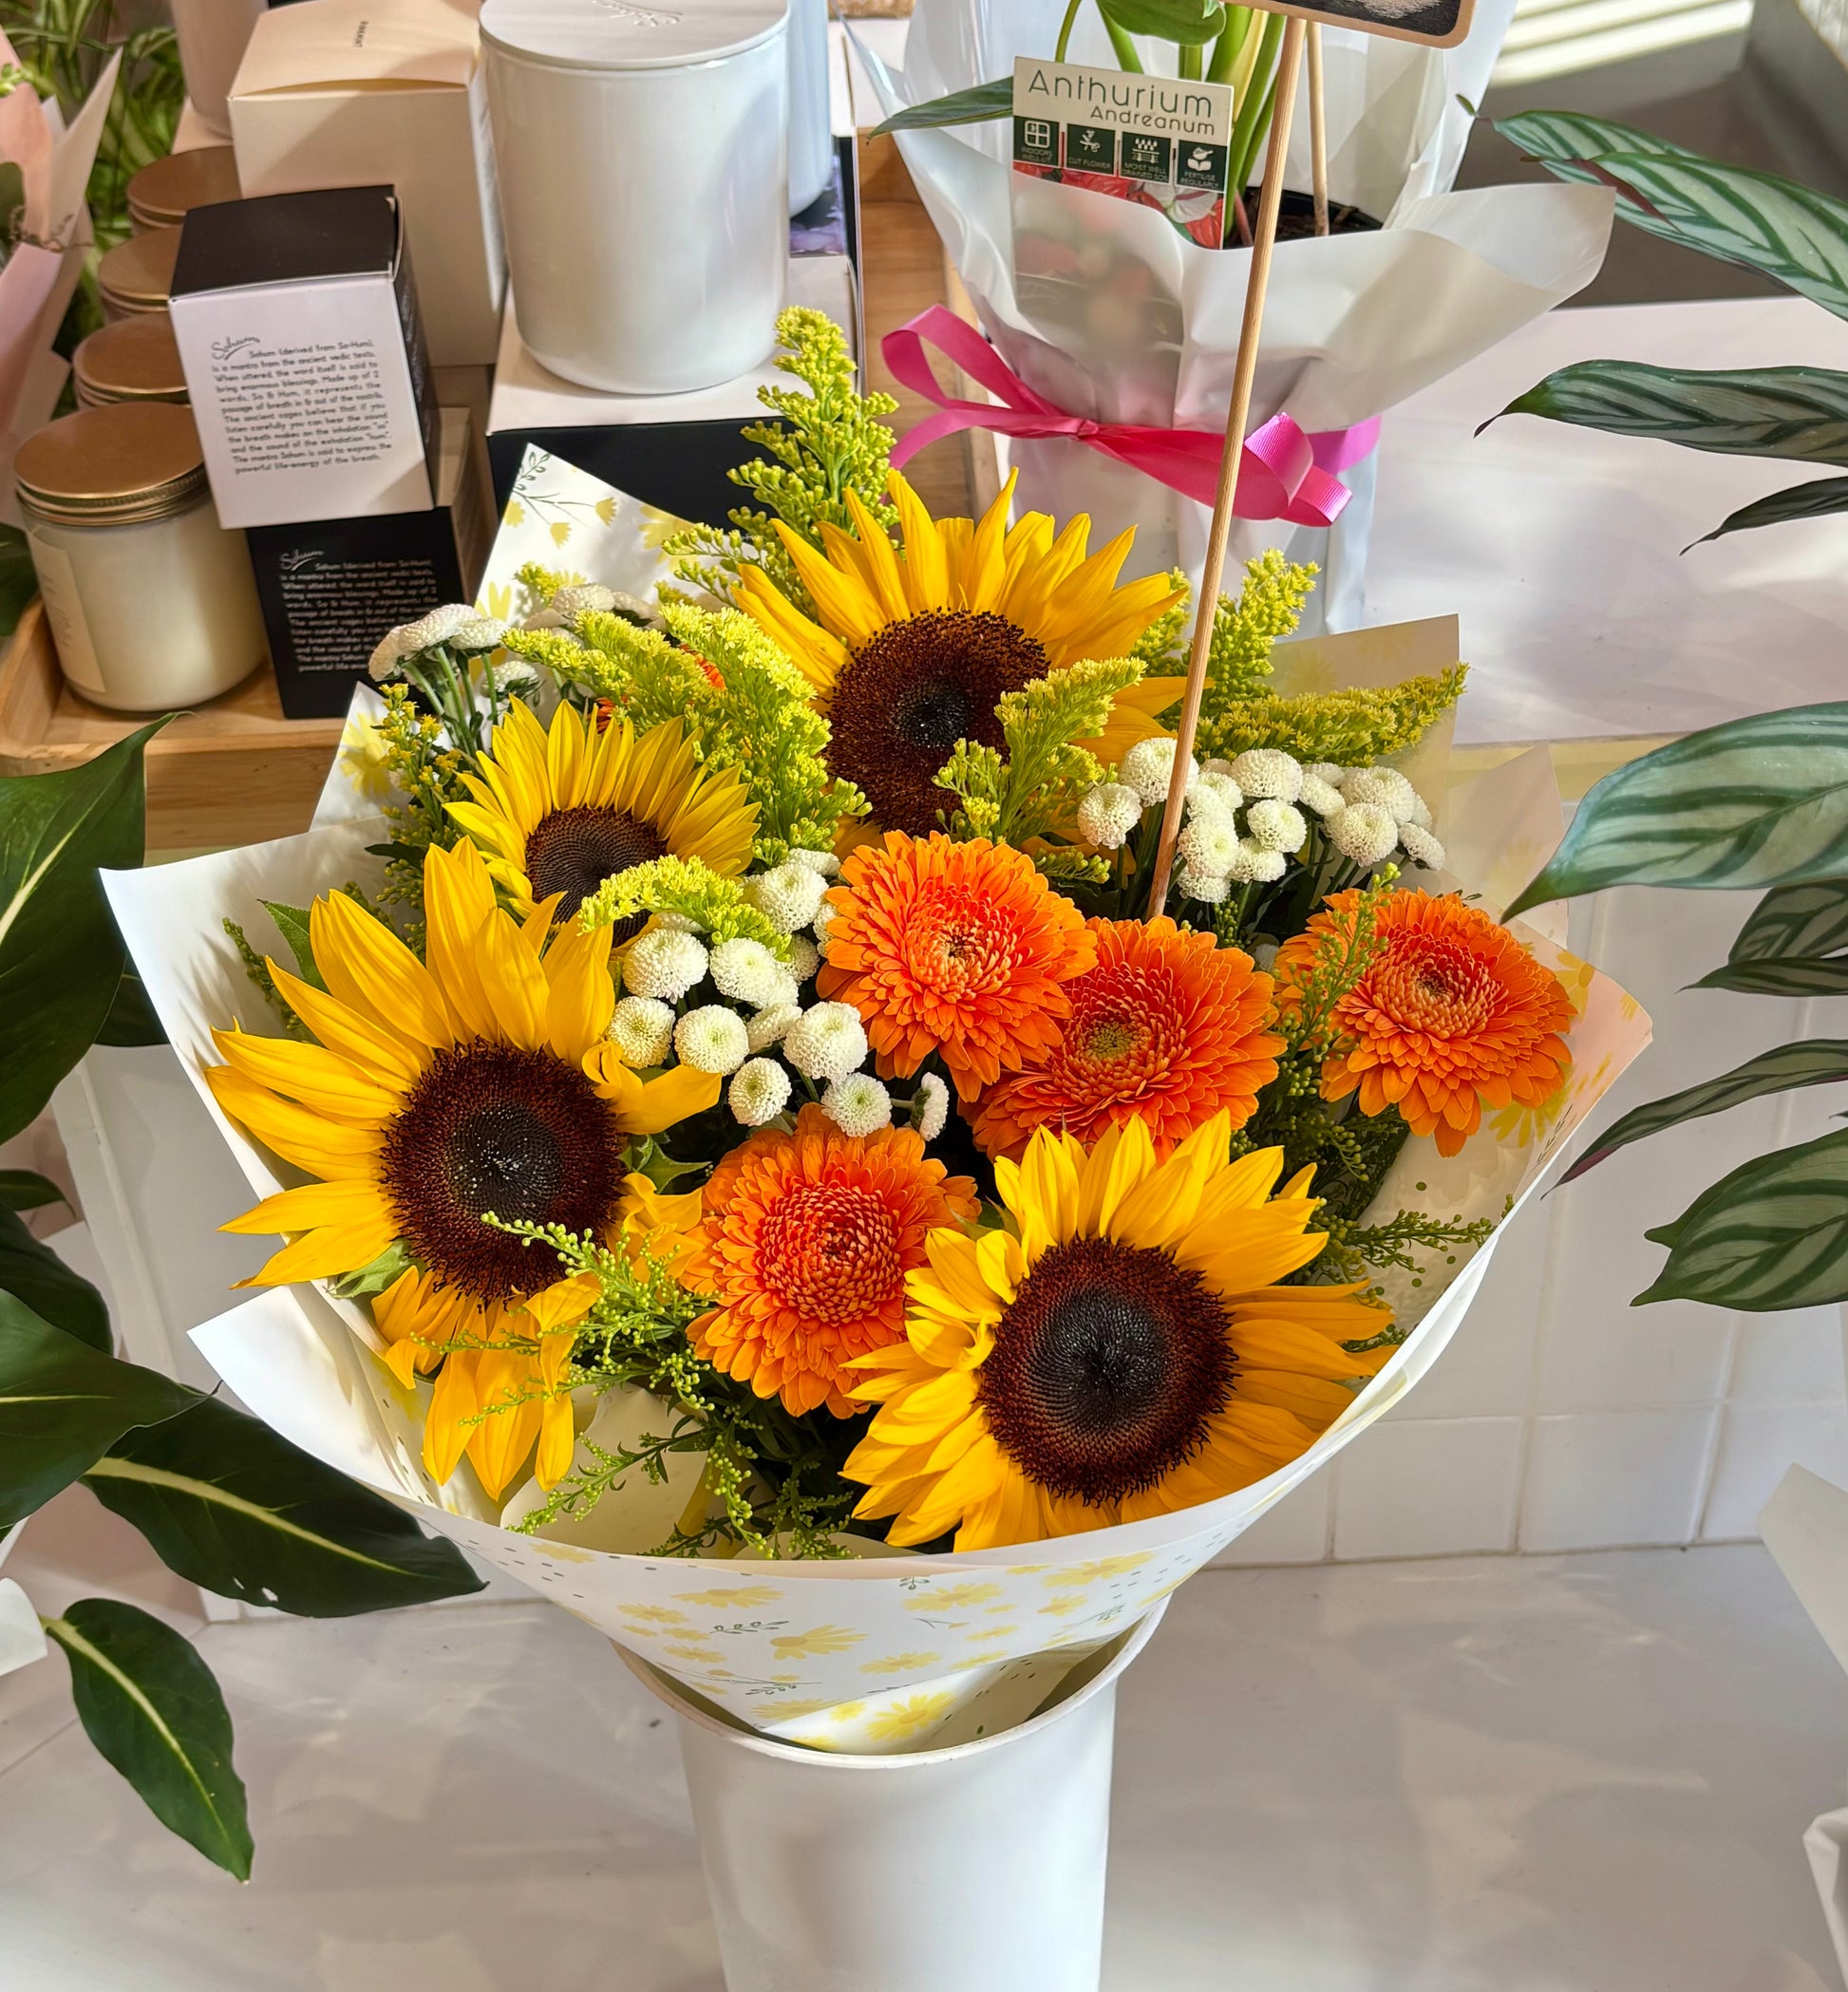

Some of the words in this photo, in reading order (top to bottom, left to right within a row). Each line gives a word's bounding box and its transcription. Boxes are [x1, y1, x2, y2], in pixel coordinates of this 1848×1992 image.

[1028, 69, 1213, 119] Anthurium
[1090, 105, 1216, 136] Andreanum
[1068, 157, 1083, 165] CUT
[1084, 159, 1112, 169] FLOWER
[1124, 162, 1145, 172] MOIST
[1148, 165, 1167, 176] WELL
